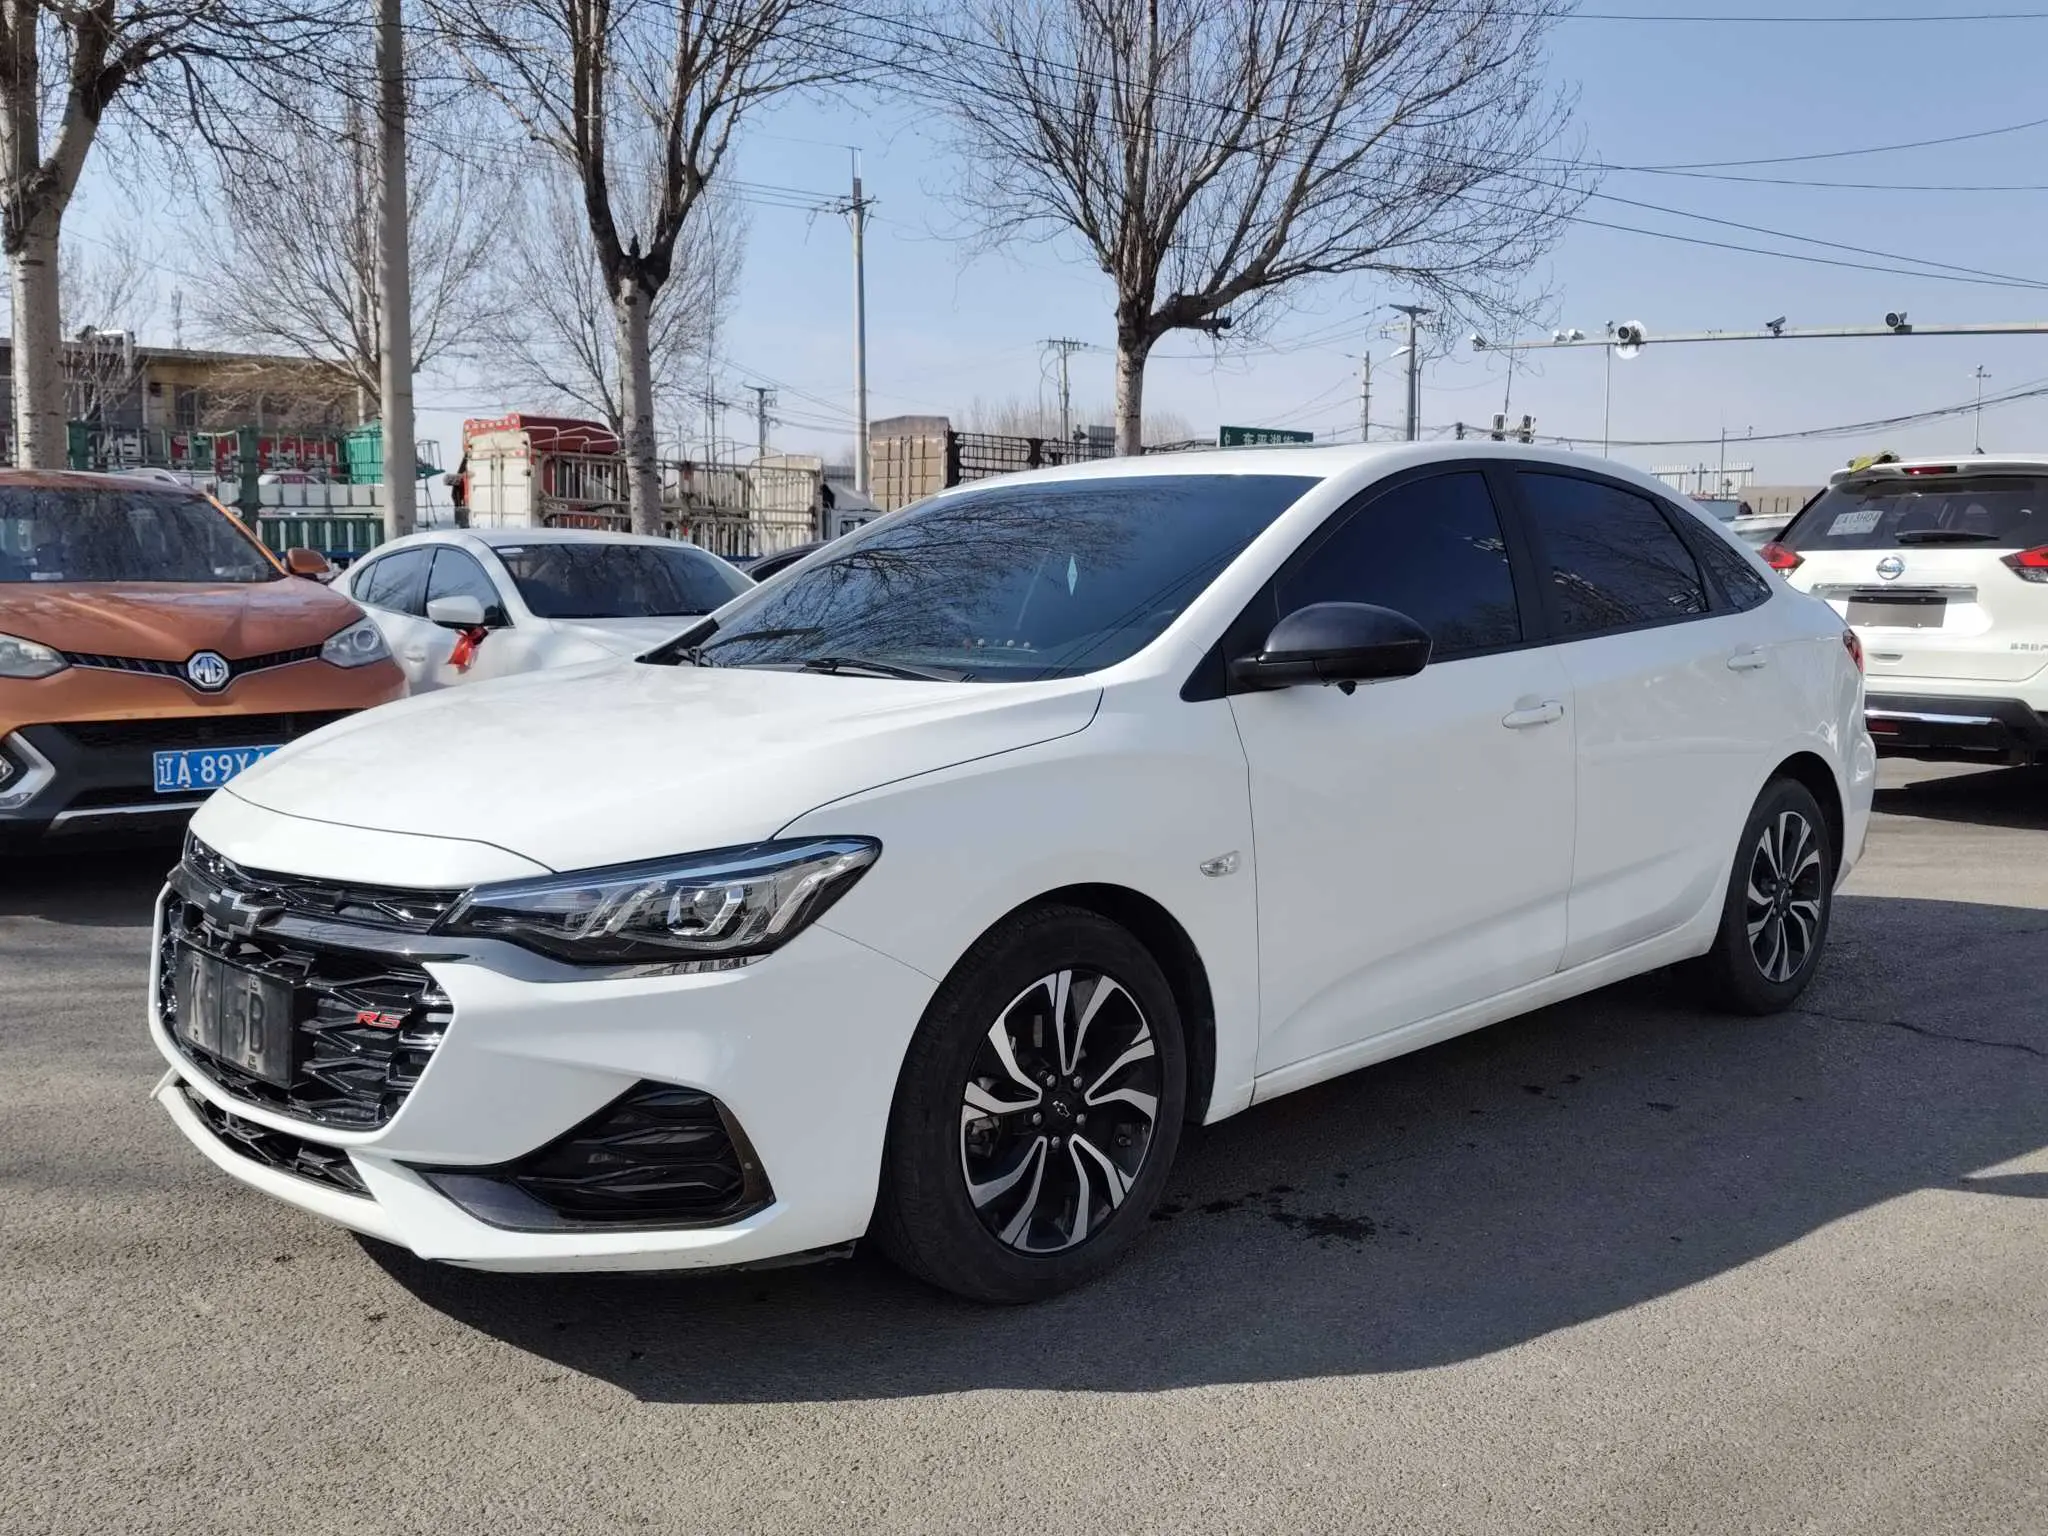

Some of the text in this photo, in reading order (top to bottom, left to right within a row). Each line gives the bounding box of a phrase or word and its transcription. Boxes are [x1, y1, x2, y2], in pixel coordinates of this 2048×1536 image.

[192, 656, 225, 683] MG
[158, 752, 266, 786] 辽A·89Y
[355, 1009, 404, 1030] RS
